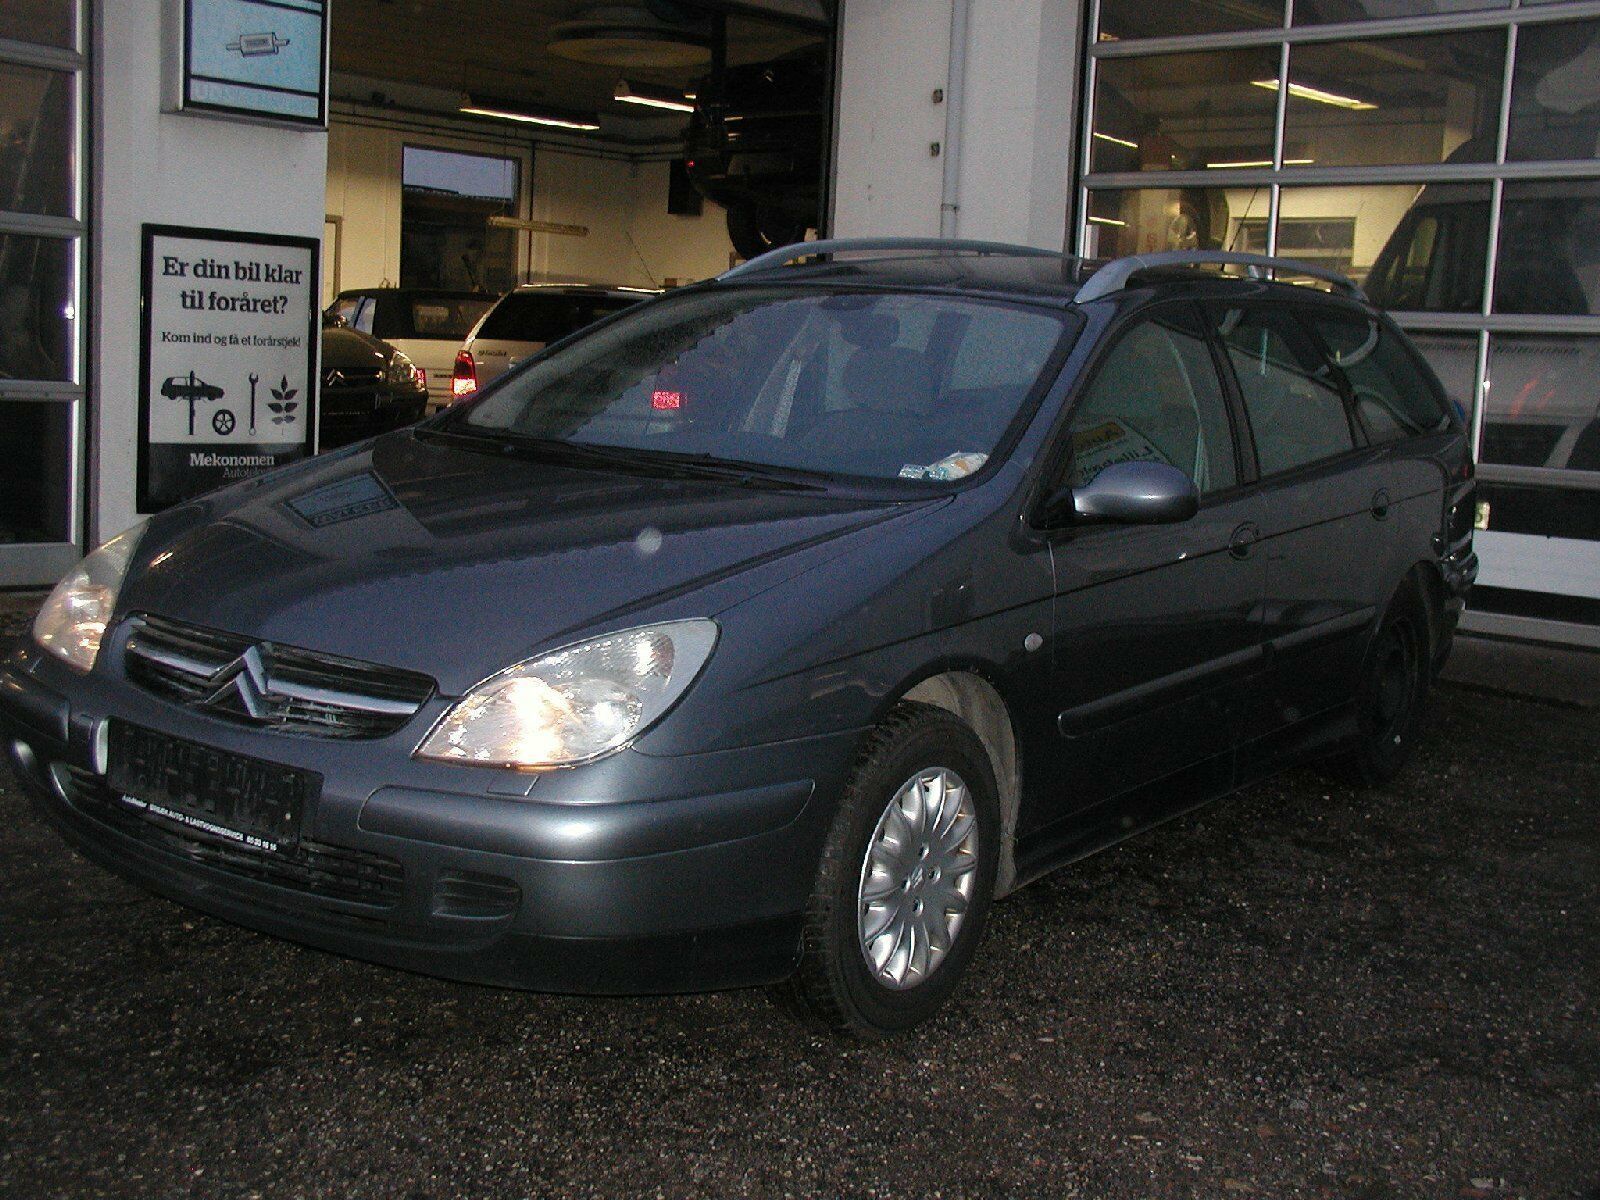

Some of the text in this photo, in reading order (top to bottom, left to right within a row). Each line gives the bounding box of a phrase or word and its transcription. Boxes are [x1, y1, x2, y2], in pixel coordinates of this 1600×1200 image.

[162, 256, 302, 285] Er din bil klar
[181, 290, 288, 314] til foråret?
[162, 331, 301, 349] Kom ind og få et forårstjek!
[189, 452, 275, 467] Mekonomen
